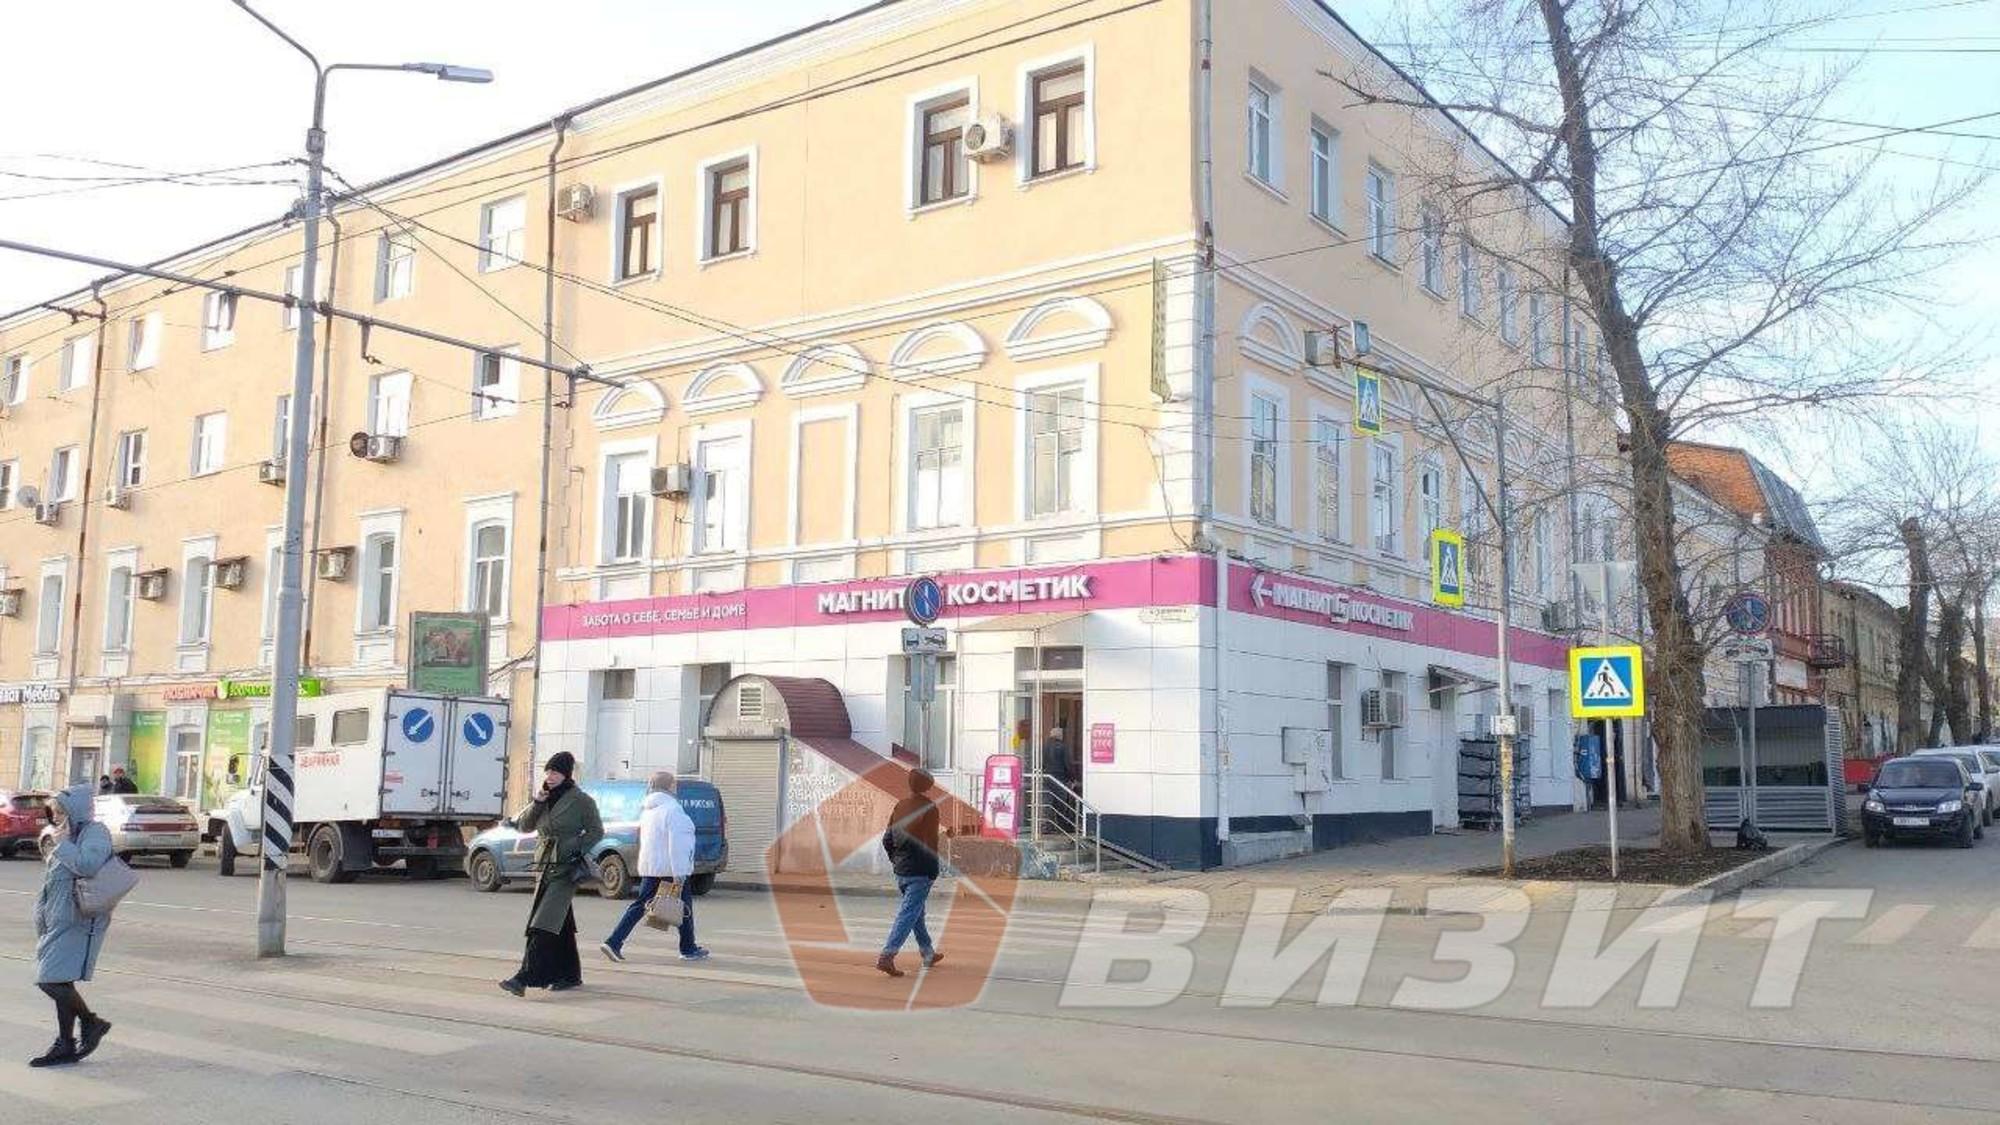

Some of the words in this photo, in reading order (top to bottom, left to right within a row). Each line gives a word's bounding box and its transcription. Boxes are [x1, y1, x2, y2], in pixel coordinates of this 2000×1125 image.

[817, 588, 906, 613] МАГНИТ
[946, 575, 1091, 606] КОСМЕТИК
[1273, 583, 1331, 615] МАГНИТ
[1351, 600, 1414, 631] КОСМЕТИК
[583, 611, 621, 627] ЗАБОТА
[622, 611, 631, 624] О
[632, 610, 663, 624] СЕБЕ,
[664, 607, 700, 621] СЕМЬЕ
[701, 605, 710, 618] И
[711, 603, 747, 619] ДОМЕ
